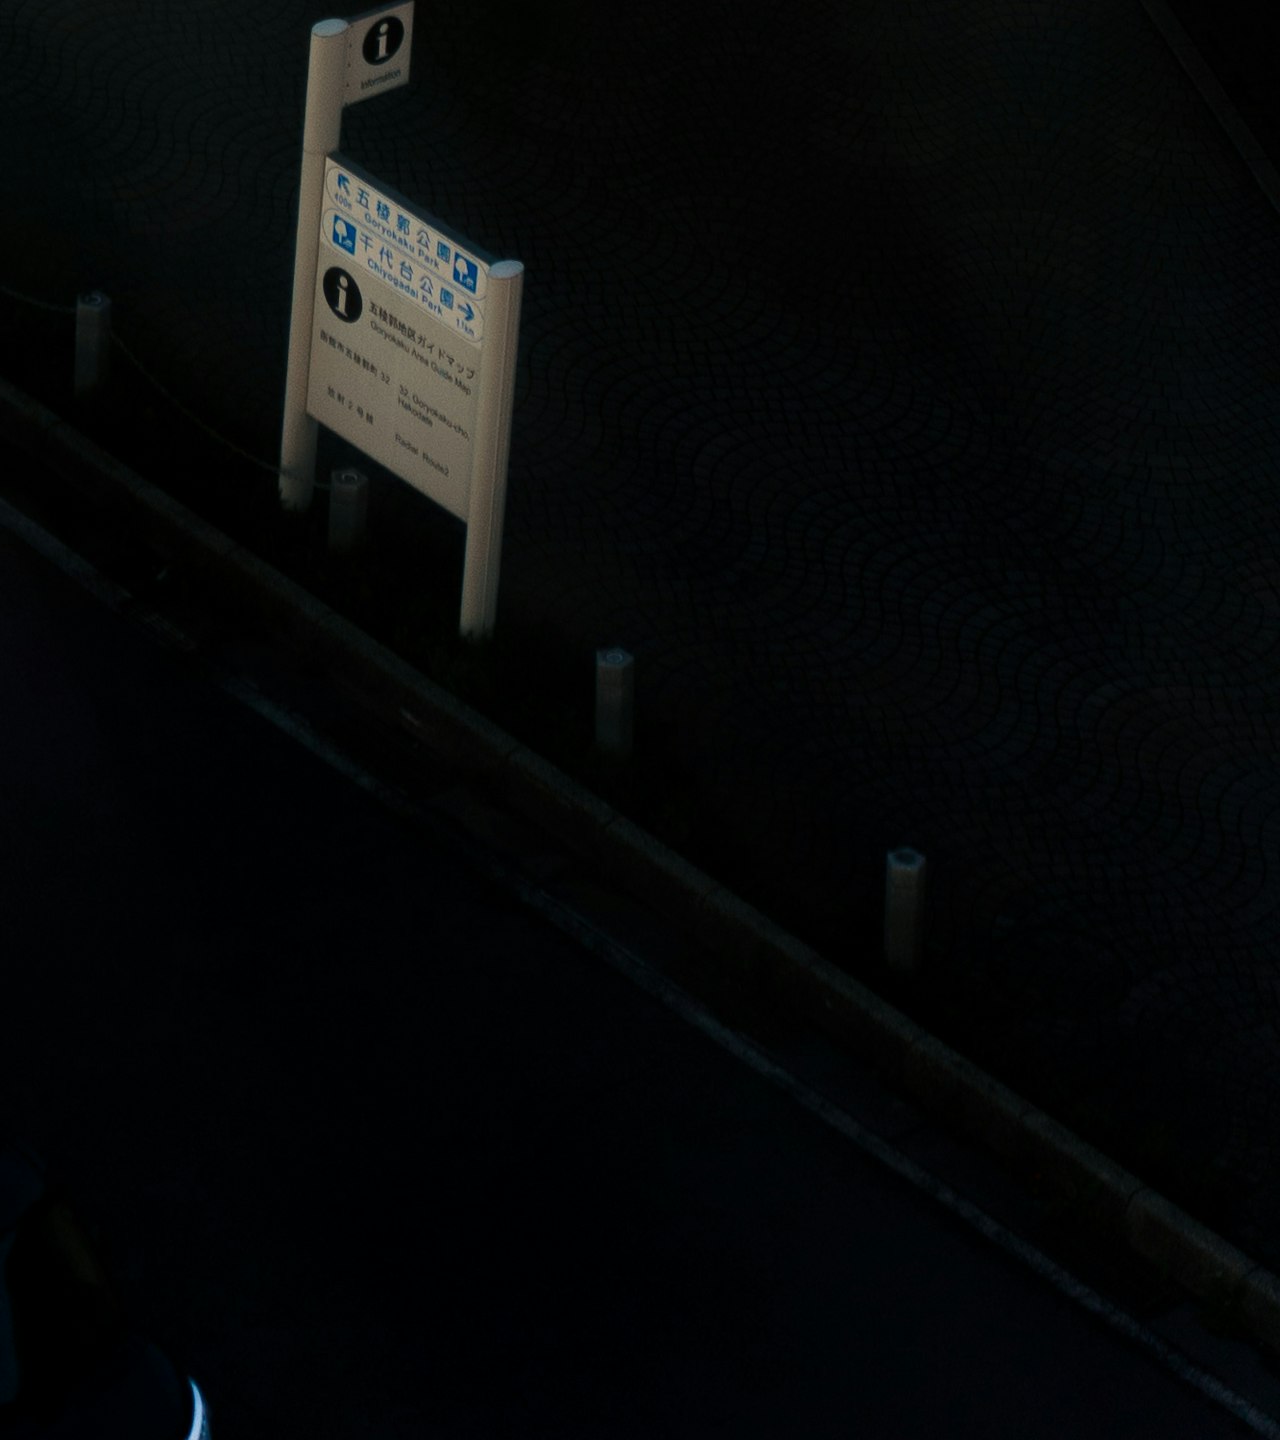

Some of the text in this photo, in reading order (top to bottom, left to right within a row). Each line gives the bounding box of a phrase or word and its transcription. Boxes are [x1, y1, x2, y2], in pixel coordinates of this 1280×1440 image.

[361, 69, 401, 90] Information
[355, 187, 451, 264] 五稜郭公園
[364, 212, 440, 270] Goryokaku Park
[359, 231, 454, 310] 千代台公園
[367, 258, 443, 317] Chiyogadai Park
[368, 301, 475, 380] 五稜郭地区ガイドマップ
[370, 320, 472, 396] Goryokaku Area Guide Map
[397, 396, 434, 428] Hakodate
